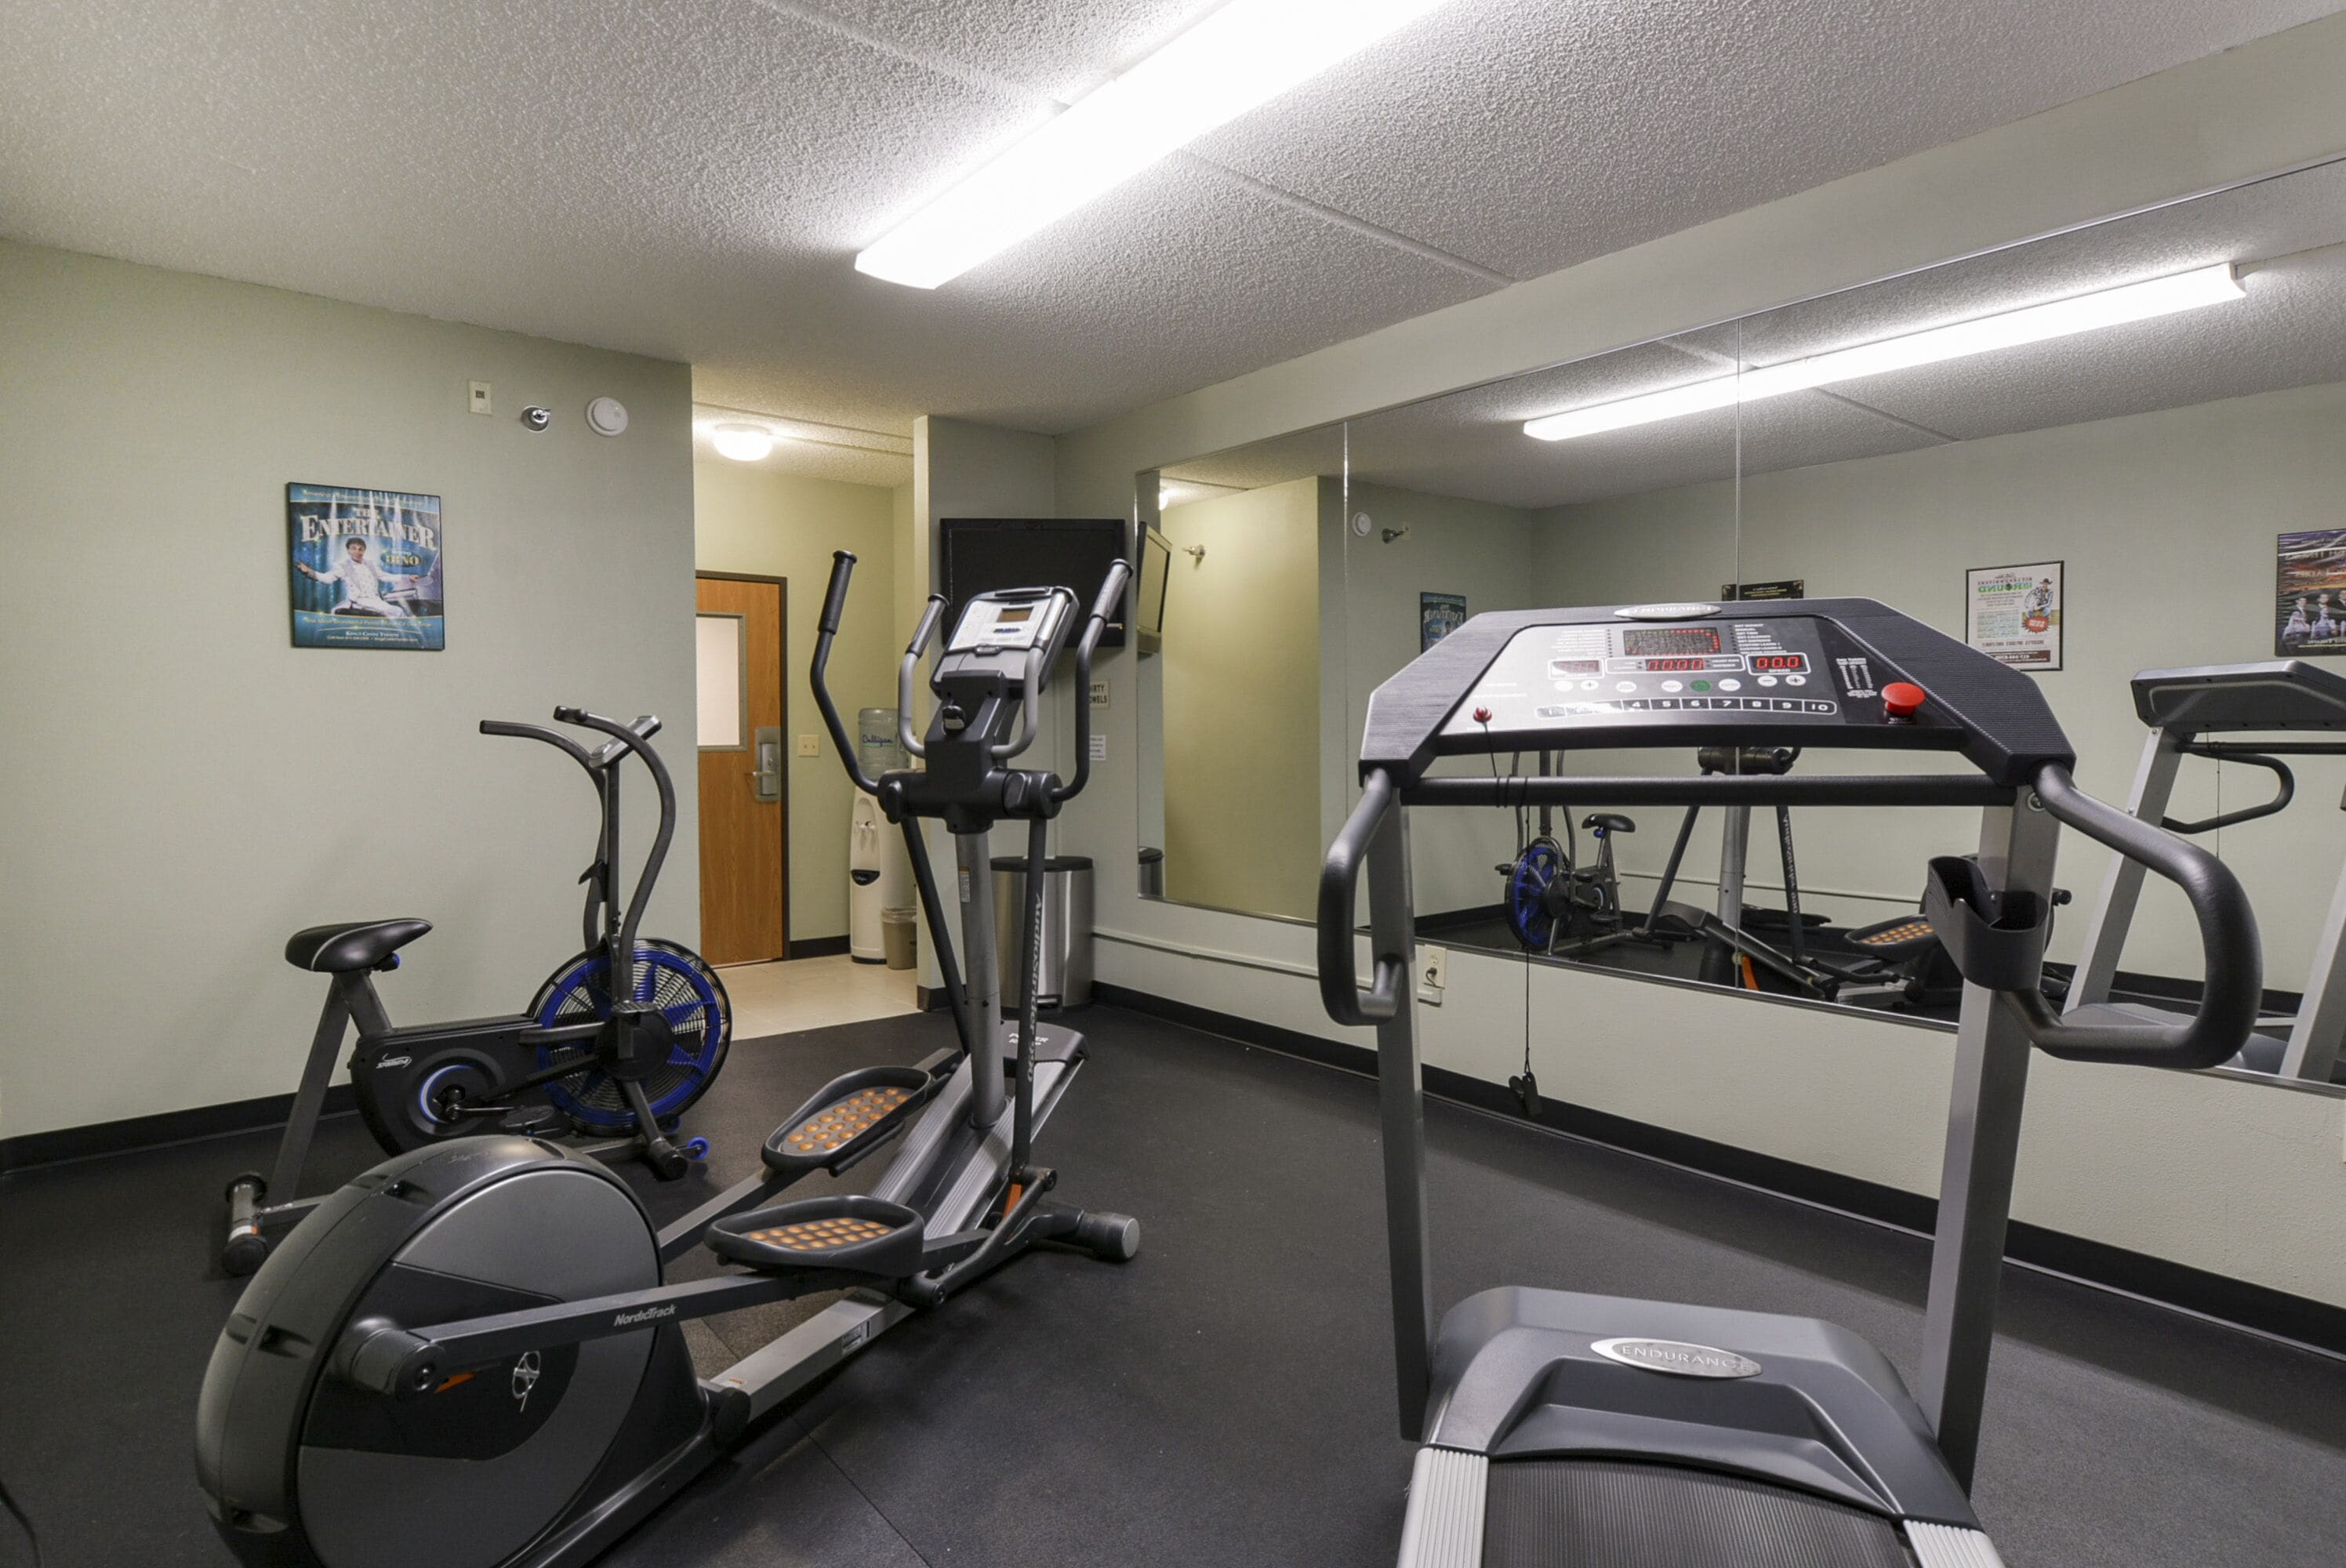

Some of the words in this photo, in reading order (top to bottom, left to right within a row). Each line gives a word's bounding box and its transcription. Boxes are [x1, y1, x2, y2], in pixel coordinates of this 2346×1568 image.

[300, 514, 434, 549] ENTERTAINER
[1756, 655, 1801, 669] 00.0
[862, 734, 893, 747] Culligan
[613, 1304, 677, 1327] NordicTrack
[1621, 1345, 1753, 1371] ENDURANCE
